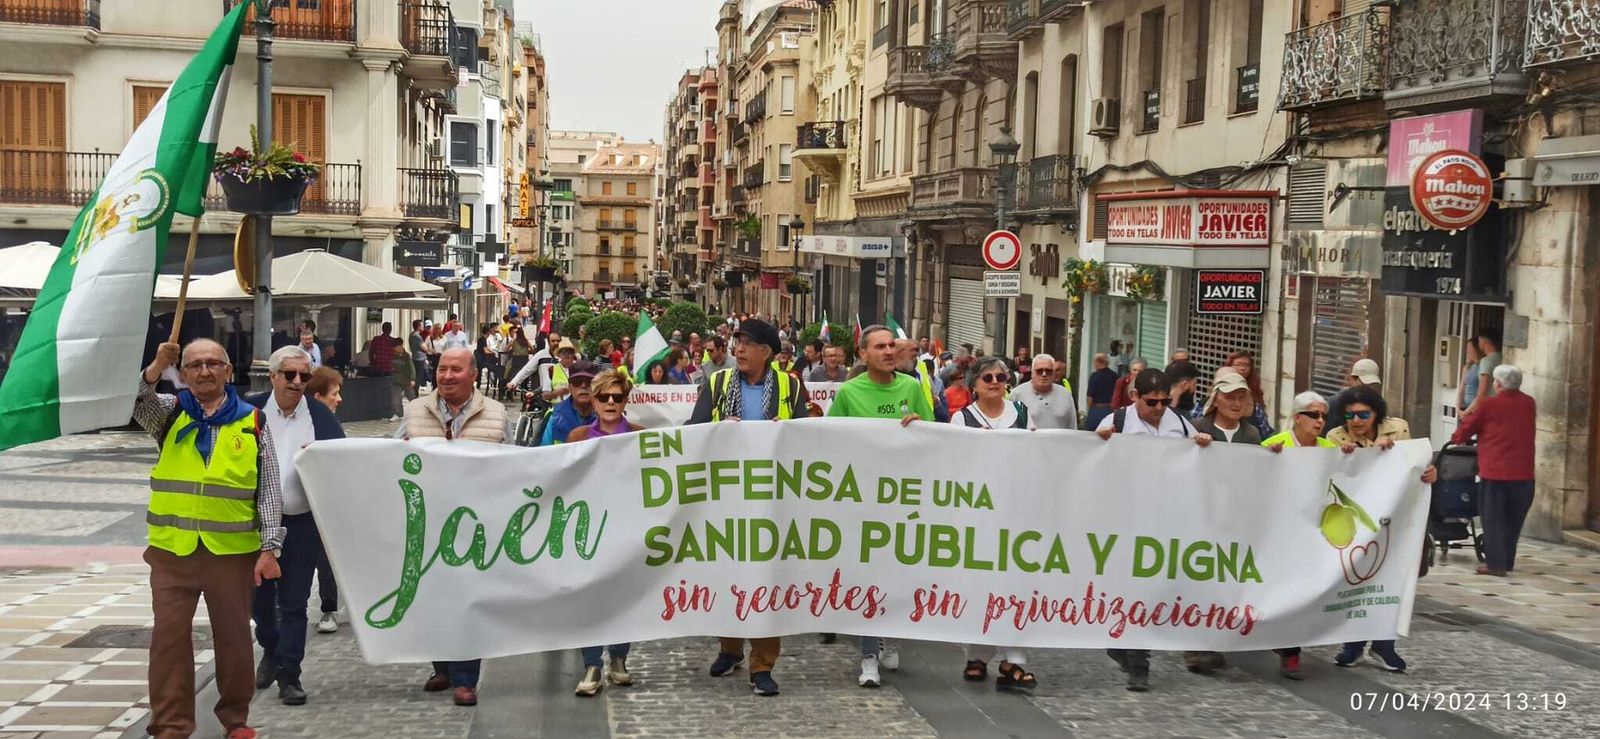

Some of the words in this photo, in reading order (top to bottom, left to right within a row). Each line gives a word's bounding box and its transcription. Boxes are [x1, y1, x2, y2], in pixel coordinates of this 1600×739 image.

[1425, 178, 1486, 195] Mahou
[520, 174, 529, 217] AMATE
[1108, 205, 1158, 227] OPORTUNIDADES
[1197, 202, 1268, 213] OPORTUNIDADES
[1160, 204, 1192, 240] JAVIER
[1198, 214, 1268, 231] JAVIER
[1109, 229, 1125, 238] TODO
[1126, 229, 1135, 238] EN
[1137, 229, 1158, 238] TELAS
[1198, 231, 1222, 240] TODO
[1225, 231, 1237, 240] EN
[1240, 231, 1268, 240] TELAS
[862, 243, 884, 251] asisa
[1203, 285, 1256, 298] JAVIER
[1435, 277, 1461, 294] 1974
[632, 392, 668, 404] LINARES
[671, 392, 683, 402] EN
[877, 404, 896, 415] #SOS
[639, 429, 683, 459] EN
[640, 459, 862, 508] DEFENSA
[877, 477, 922, 506] DE
[932, 480, 993, 510] UNA
[644, 518, 842, 567] SANIDAD
[860, 512, 1070, 575] PÚBLICA
[1086, 532, 1119, 577] Y
[1132, 536, 1264, 584] DIGNA
[660, 580, 717, 622] sin
[730, 567, 887, 621] recortes,
[908, 584, 968, 623] sin
[982, 582, 1260, 638] privatizaciones
